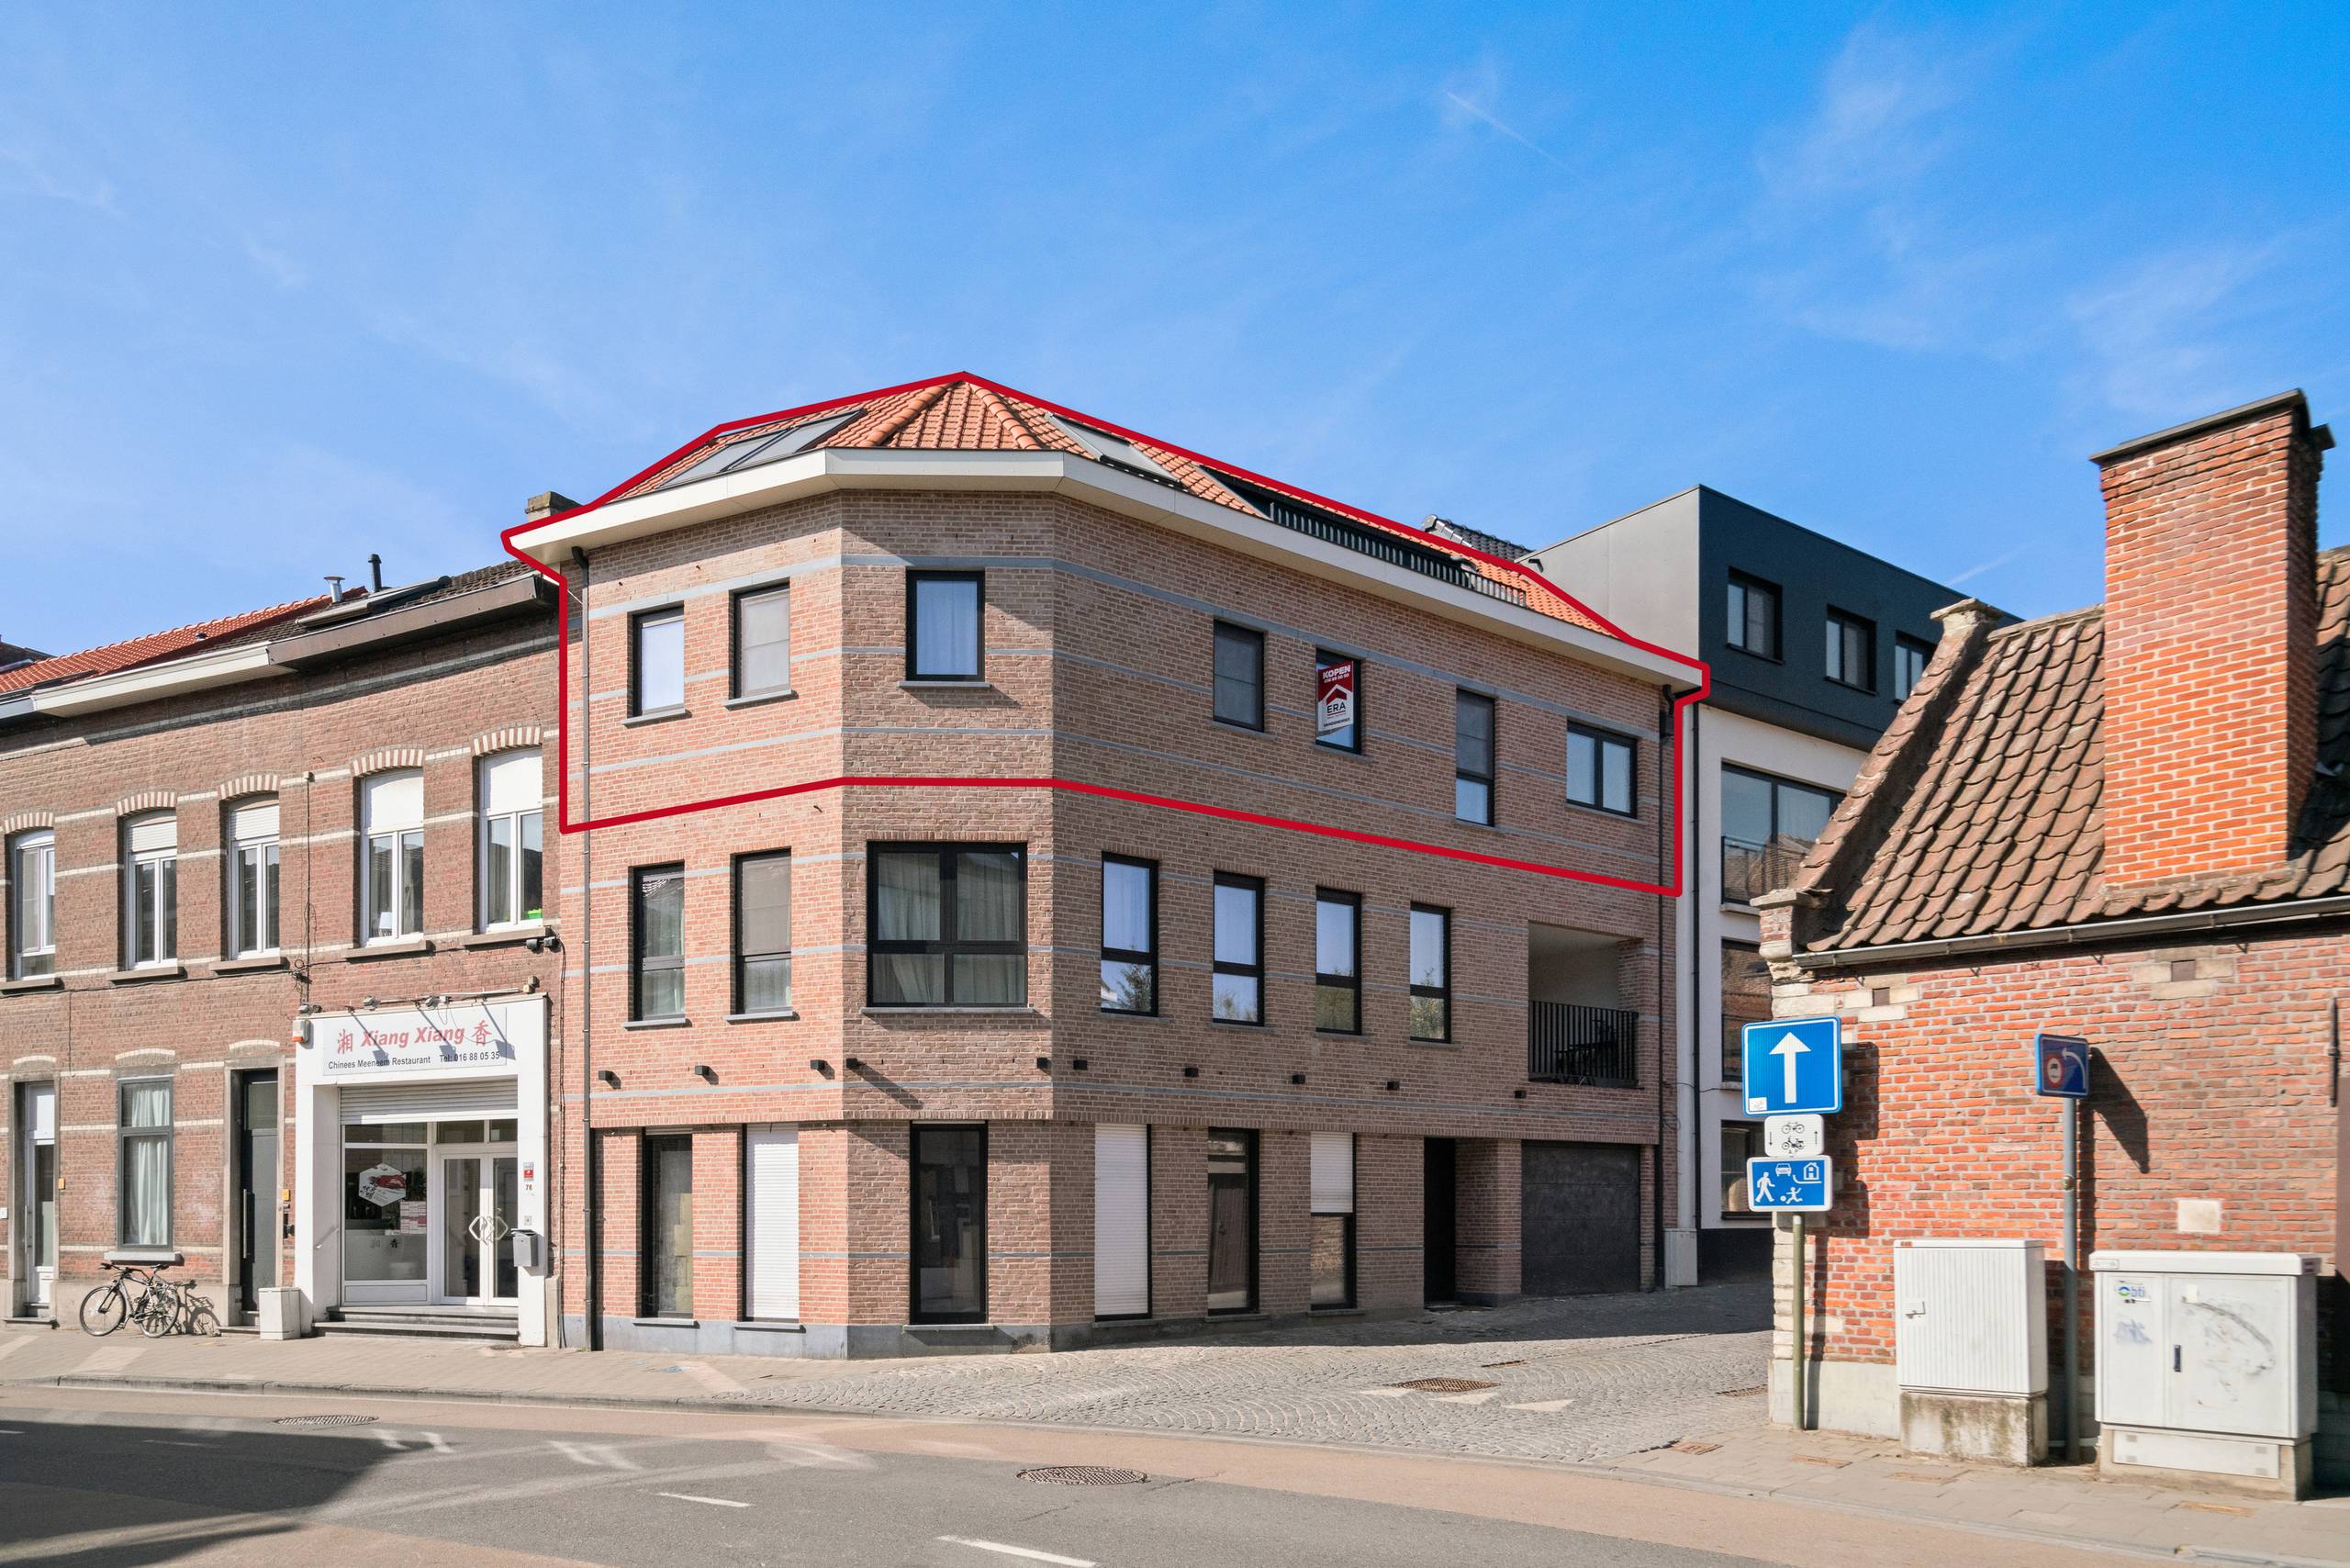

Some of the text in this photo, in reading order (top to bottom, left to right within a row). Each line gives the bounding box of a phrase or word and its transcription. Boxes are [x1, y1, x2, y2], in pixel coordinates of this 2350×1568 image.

[1322, 666, 1351, 679] KOPEN
[1326, 701, 1346, 712] ERA
[337, 1019, 492, 1055] 湘 Xiang Xiang 香
[328, 1060, 356, 1070] Chinees
[392, 1056, 431, 1066] Restaurant
[439, 1051, 500, 1062] Tel: 016 88 05 35
